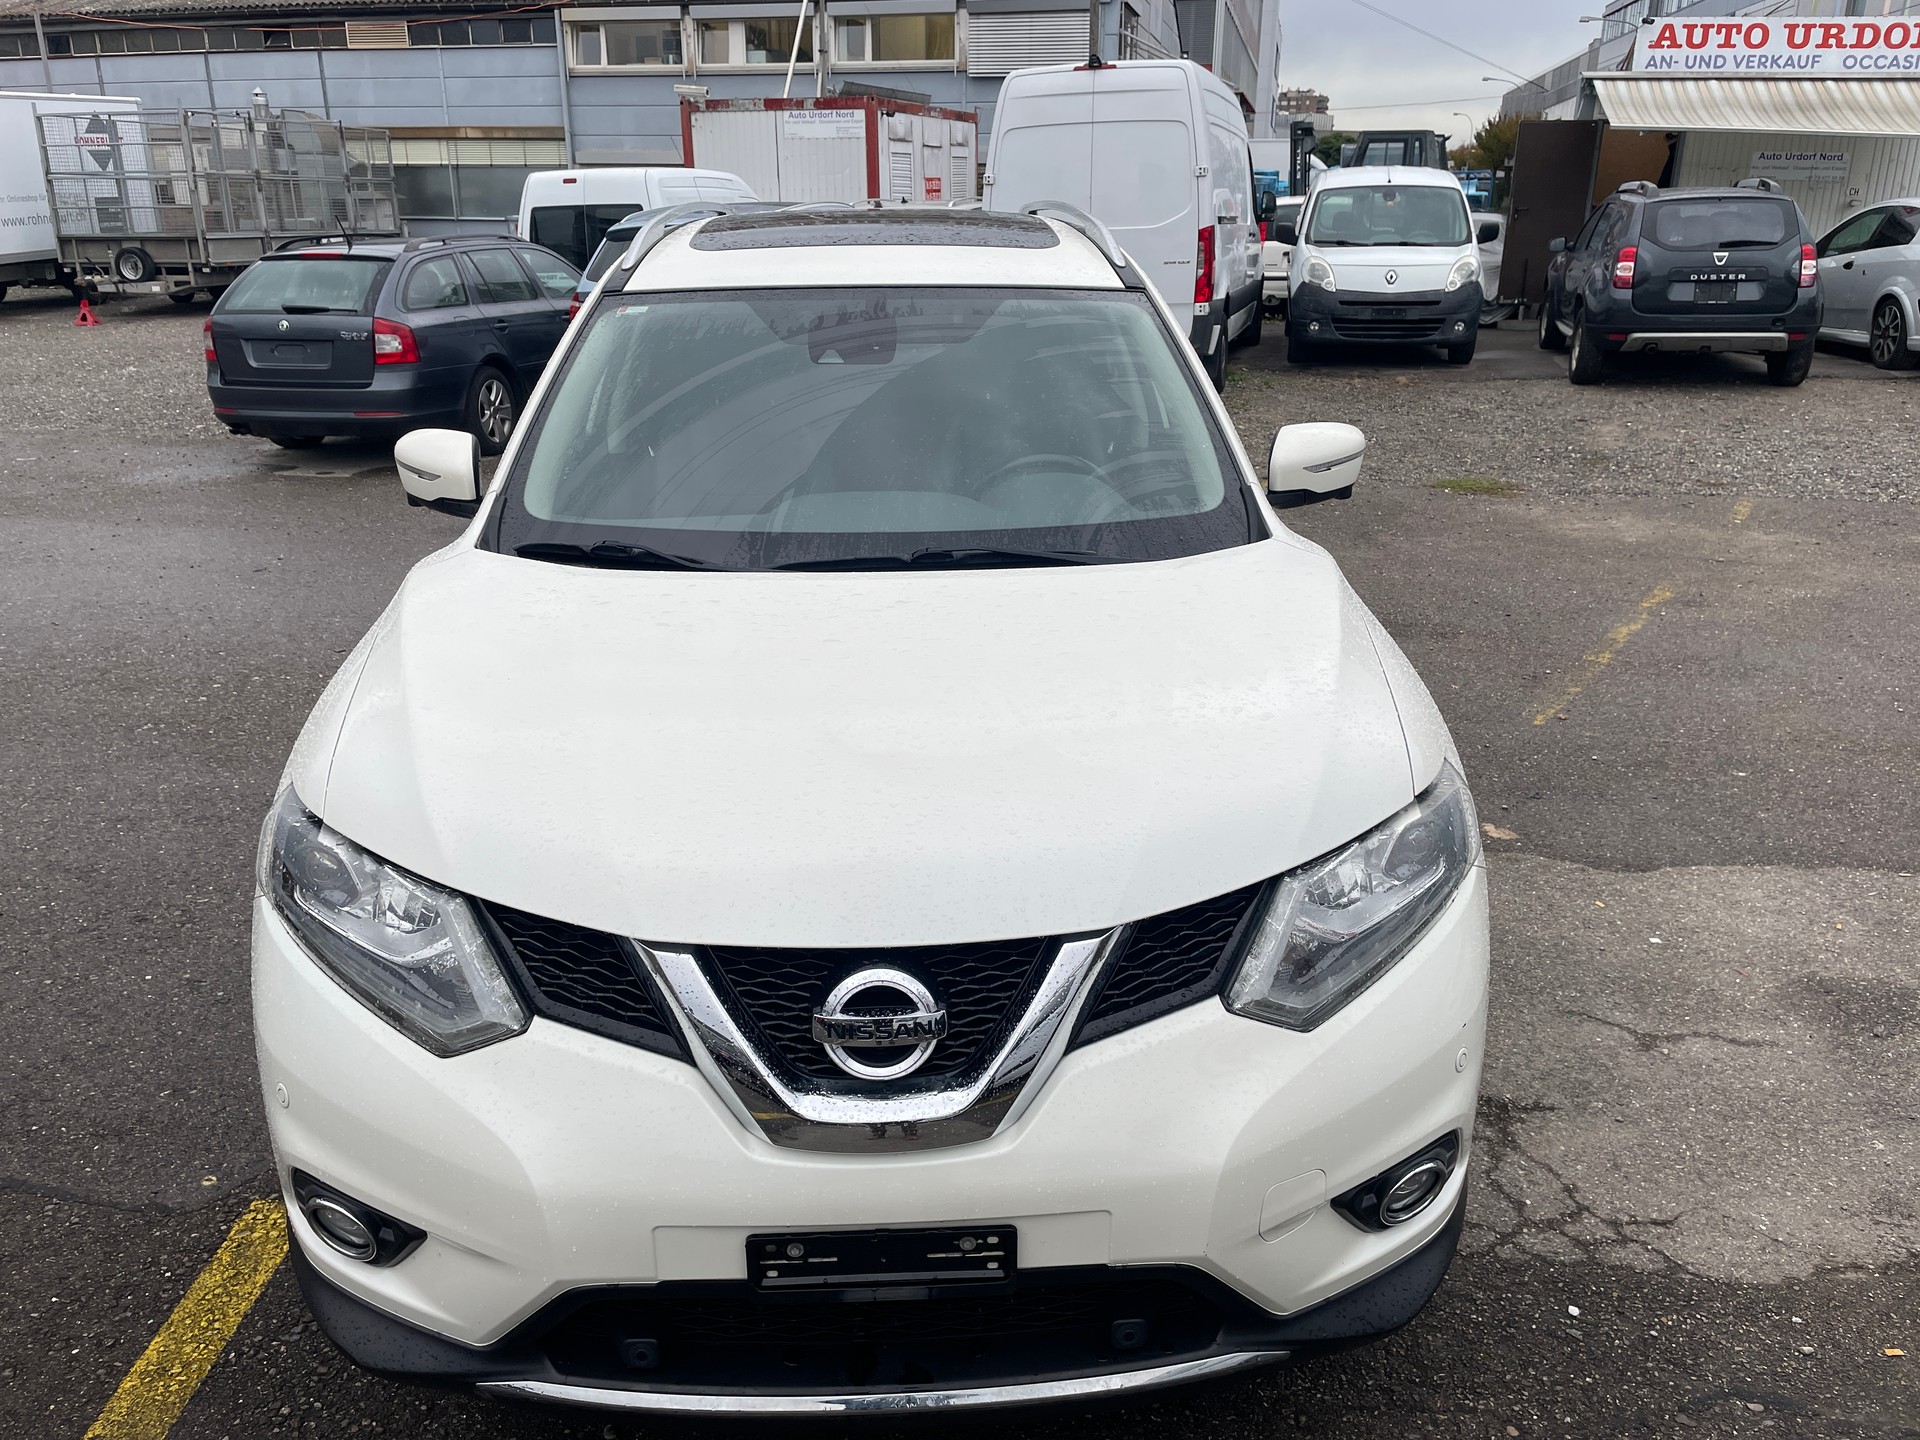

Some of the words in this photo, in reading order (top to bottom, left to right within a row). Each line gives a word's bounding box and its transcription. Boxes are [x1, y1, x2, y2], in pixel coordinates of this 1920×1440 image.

[1648, 22, 1770, 49] AUTO
[1645, 54, 1679, 69] AN-
[1684, 54, 1727, 69] UND
[1733, 54, 1822, 69] VERKAUF
[788, 111, 807, 119] Auto
[808, 111, 833, 119] Urdorf
[835, 110, 855, 118] Nord
[1758, 152, 1782, 161] Auto
[1785, 152, 1816, 161] Urdorf
[1819, 152, 1844, 161] Nord
[1849, 187, 1860, 197] CH
[1690, 273, 1746, 281] DUSTER
[826, 1019, 934, 1041] NISSAN
